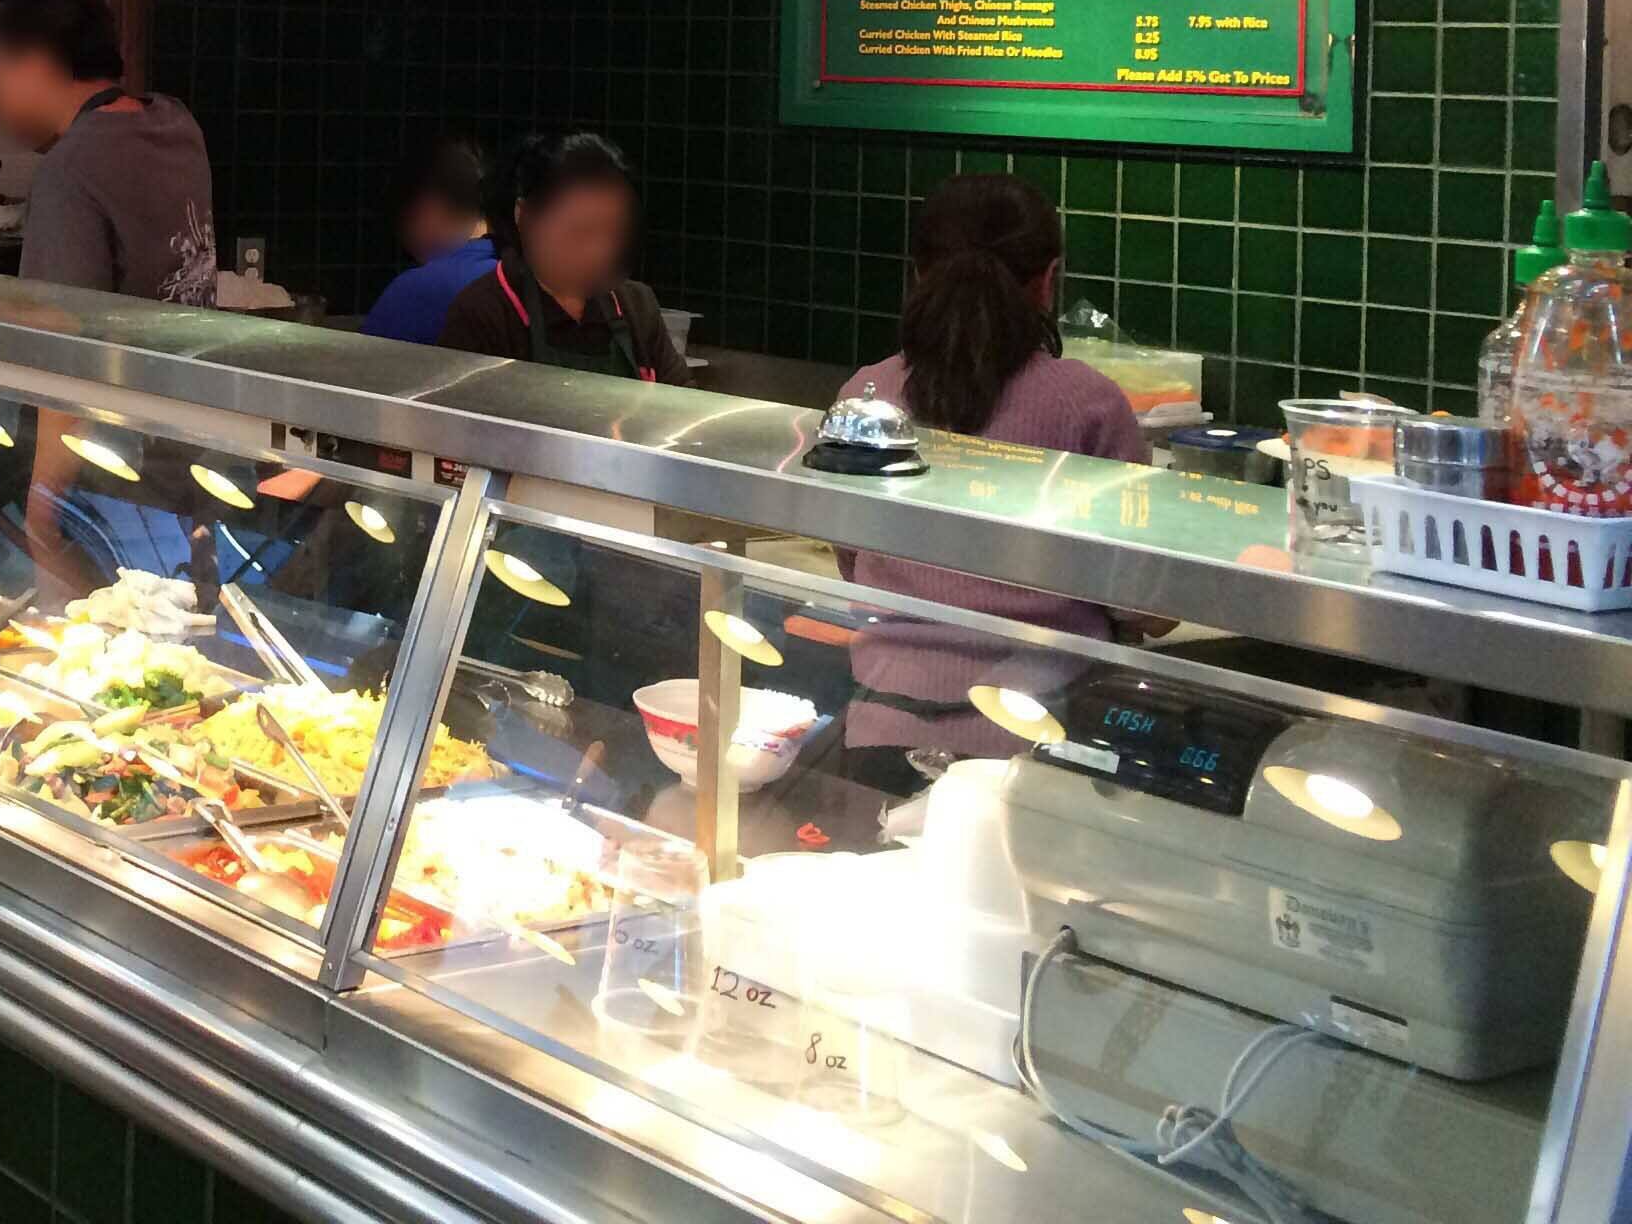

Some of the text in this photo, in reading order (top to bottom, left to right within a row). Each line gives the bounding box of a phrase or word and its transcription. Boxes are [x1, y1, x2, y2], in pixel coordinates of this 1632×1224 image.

[860, 0, 898, 10] Steamed
[901, 0, 936, 9] Chicken
[975, 0, 1012, 10] Chinese
[937, 15, 956, 25] And
[958, 15, 995, 25] Chinese
[997, 15, 1054, 26] Mushrooms
[1215, 17, 1240, 28] with
[1243, 17, 1268, 28] Rice
[859, 29, 893, 40] Curried
[895, 29, 930, 40] Chicken
[933, 30, 955, 40] With
[957, 30, 999, 41] Steamed
[1001, 30, 1022, 41] Rice
[858, 44, 892, 54] Curried
[894, 44, 930, 55] Chicken
[933, 45, 955, 55] With
[957, 45, 982, 56] Fried
[983, 46, 1004, 56] Rice
[1006, 46, 1021, 56] Or
[1022, 47, 1063, 58] Noodles
[1117, 68, 1290, 85] Please Add 5% Gst To Prices
[1104, 707, 1157, 734] CASH
[710, 966, 777, 1009] 12 oz
[805, 1032, 848, 1070] 8 oz
